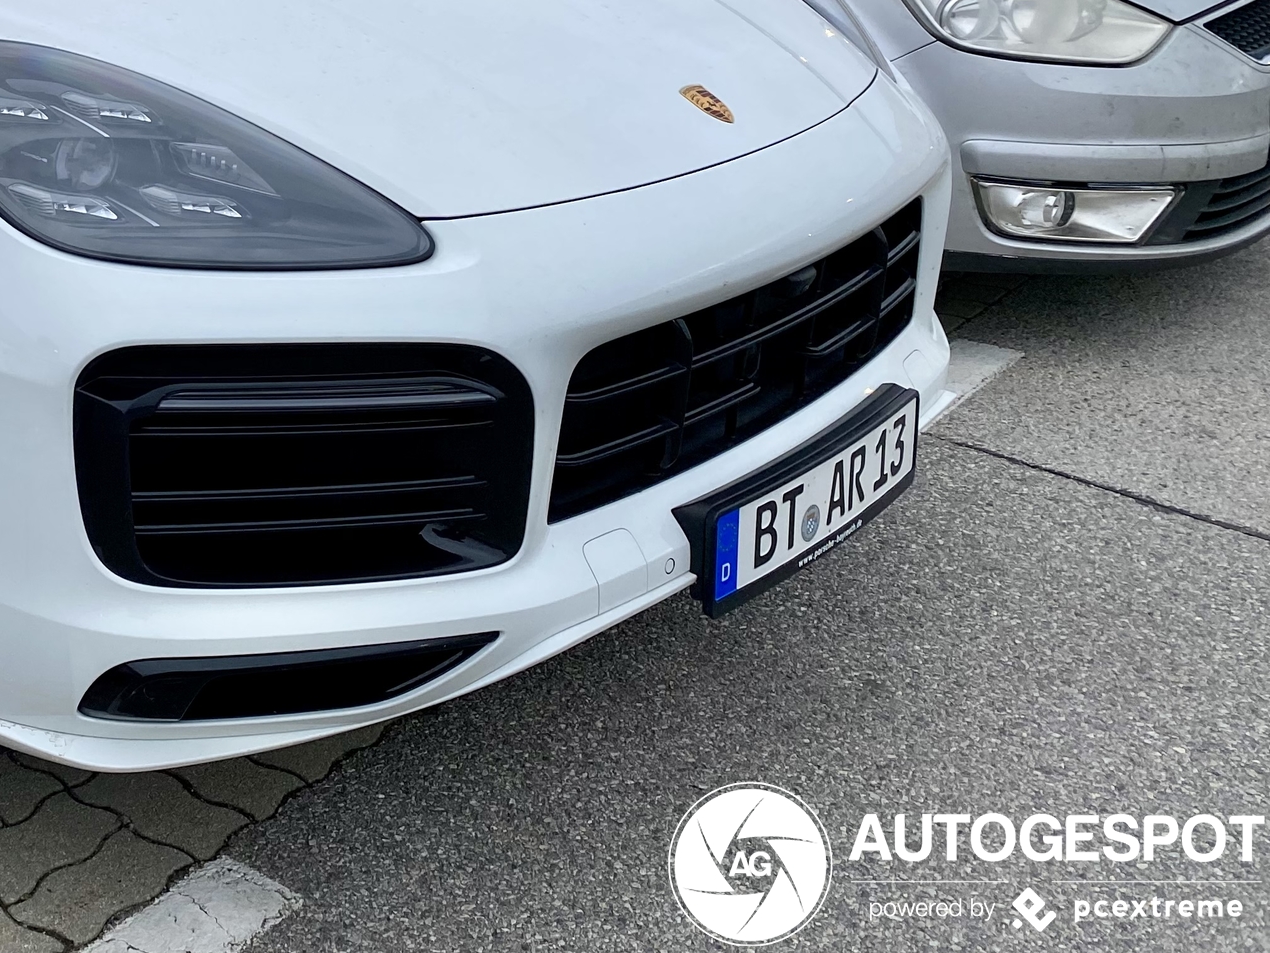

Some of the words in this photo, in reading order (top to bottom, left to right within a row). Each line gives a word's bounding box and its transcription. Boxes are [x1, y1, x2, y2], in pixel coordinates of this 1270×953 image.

[754, 484, 804, 569] BT
[827, 445, 866, 526] AR
[874, 414, 906, 492] 13
[721, 563, 731, 582] D
